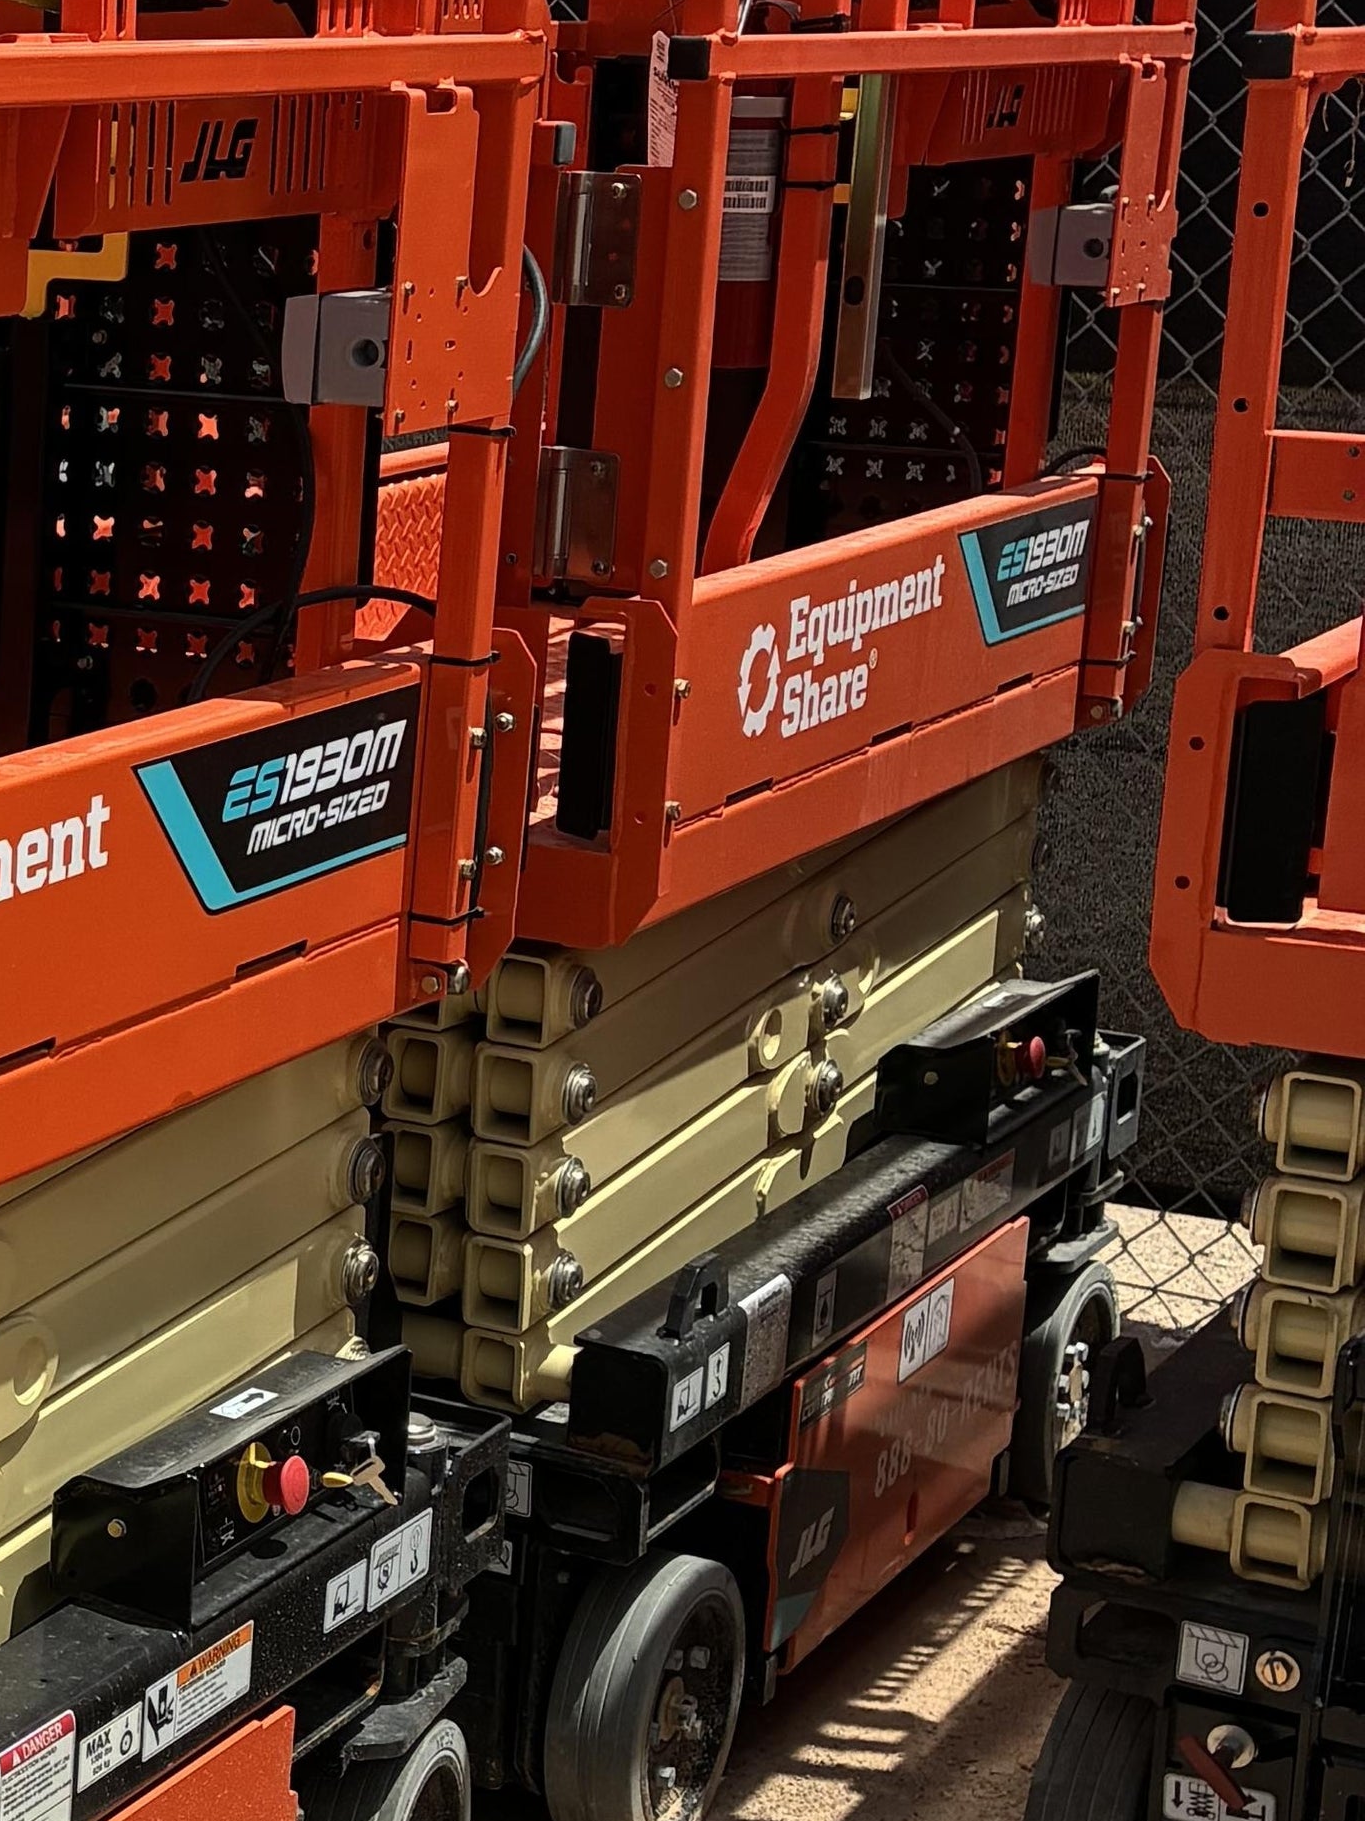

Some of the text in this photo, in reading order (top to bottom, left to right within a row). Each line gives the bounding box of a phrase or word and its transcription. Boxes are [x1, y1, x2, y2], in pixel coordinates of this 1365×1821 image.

[179, 118, 260, 184] JLG
[997, 519, 1090, 581] ES1930M
[786, 554, 946, 666] Equipment
[1006, 563, 1080, 608] MICRO-SIZED
[222, 719, 408, 823] ES1930M
[246, 780, 390, 856] MICRO-SIZED
[788, 1506, 835, 1579] JLG
[22, 1721, 63, 1759] DANGER
[85, 1727, 112, 1759] MAX
